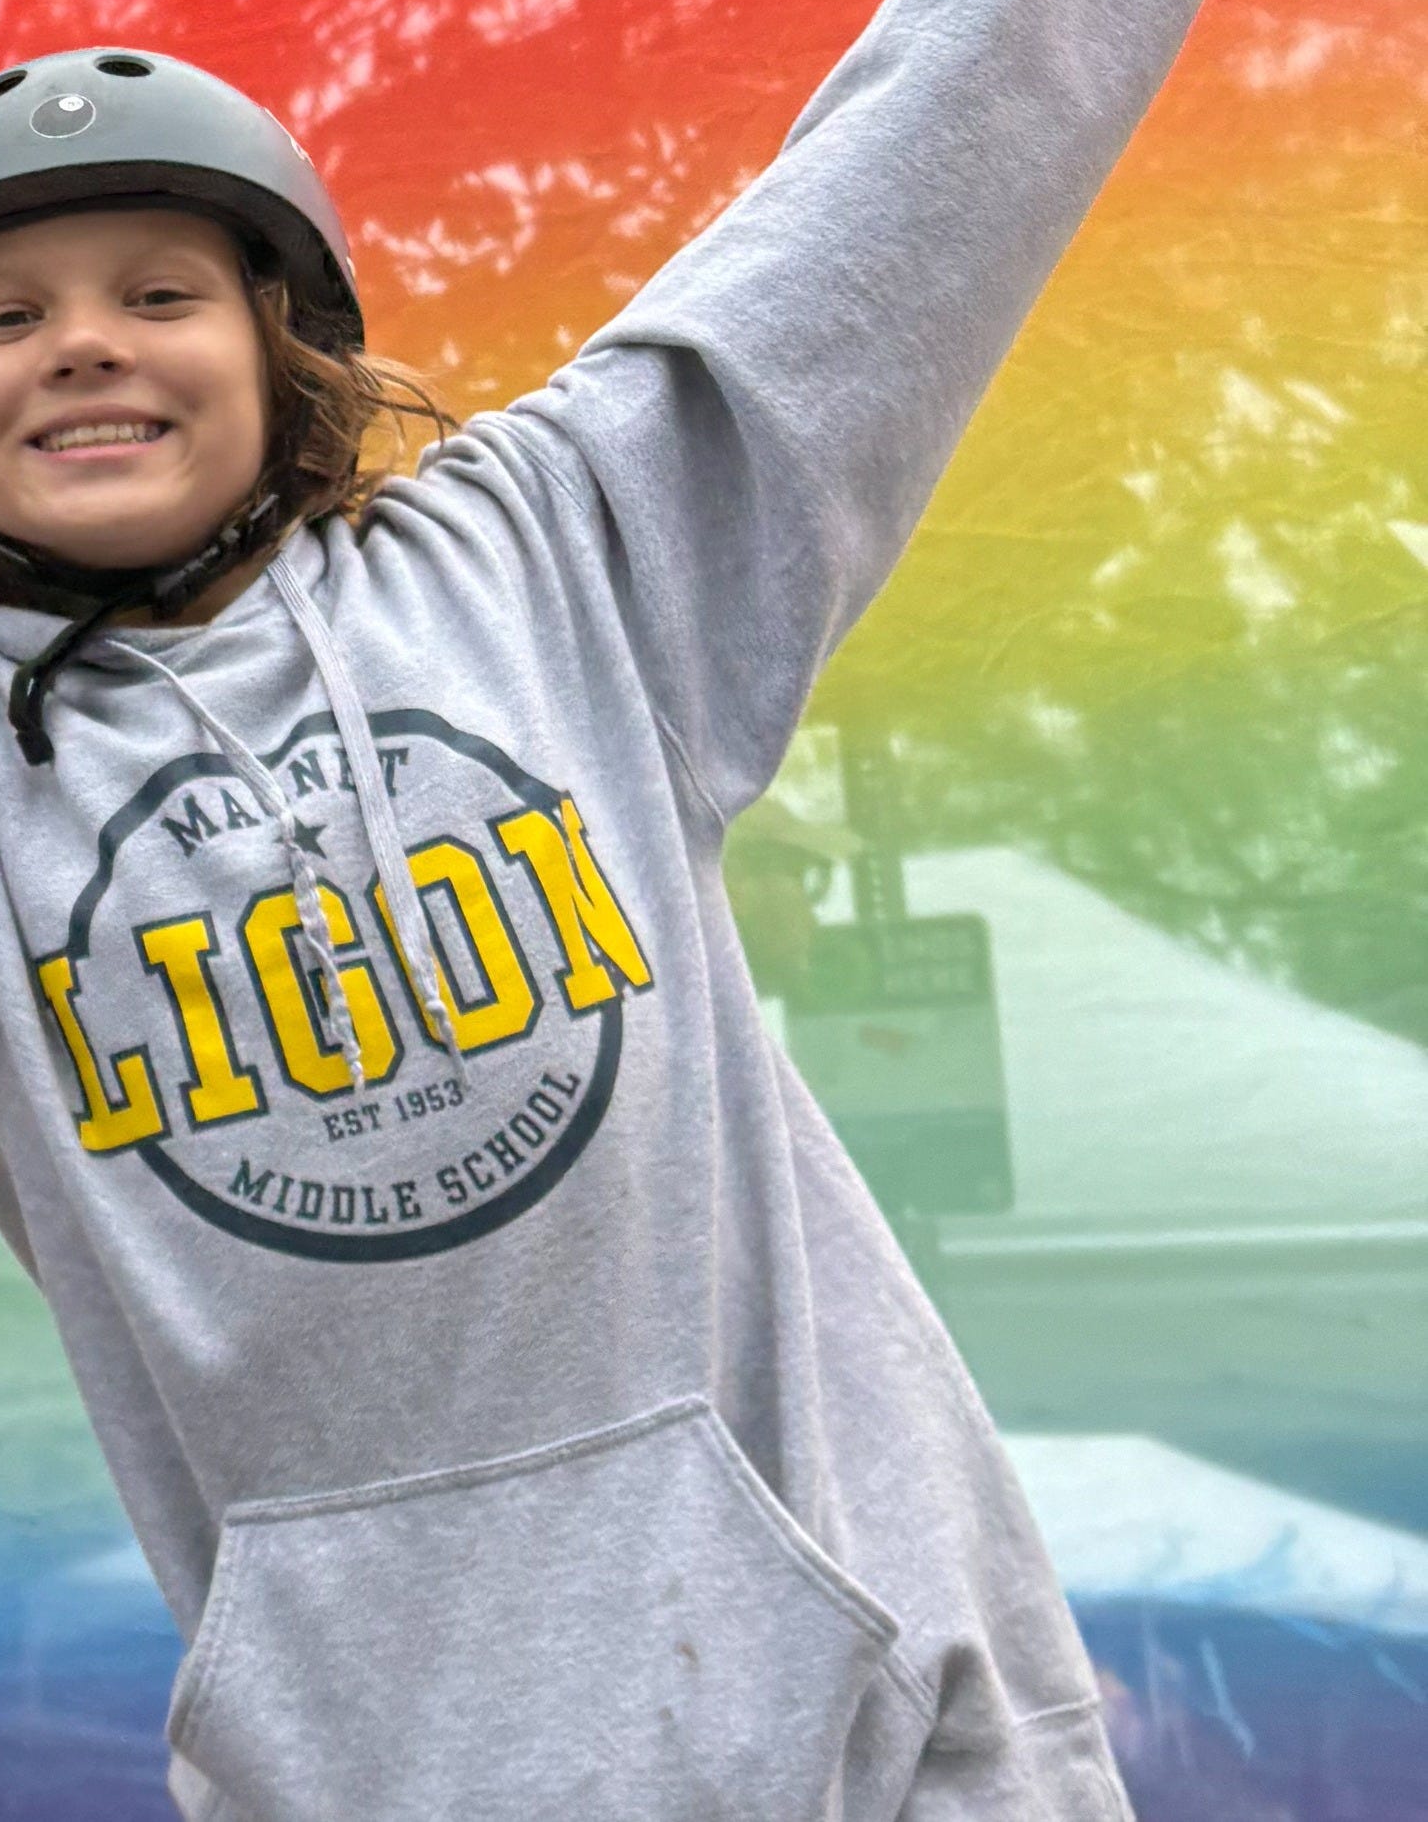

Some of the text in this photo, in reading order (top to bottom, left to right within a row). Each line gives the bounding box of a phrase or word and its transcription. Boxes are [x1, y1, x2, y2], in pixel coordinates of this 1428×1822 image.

[32, 791, 654, 1158] LIGON
[227, 1068, 582, 1225] MIDDLE SCHOOL
[323, 1078, 465, 1143] EST 1953
